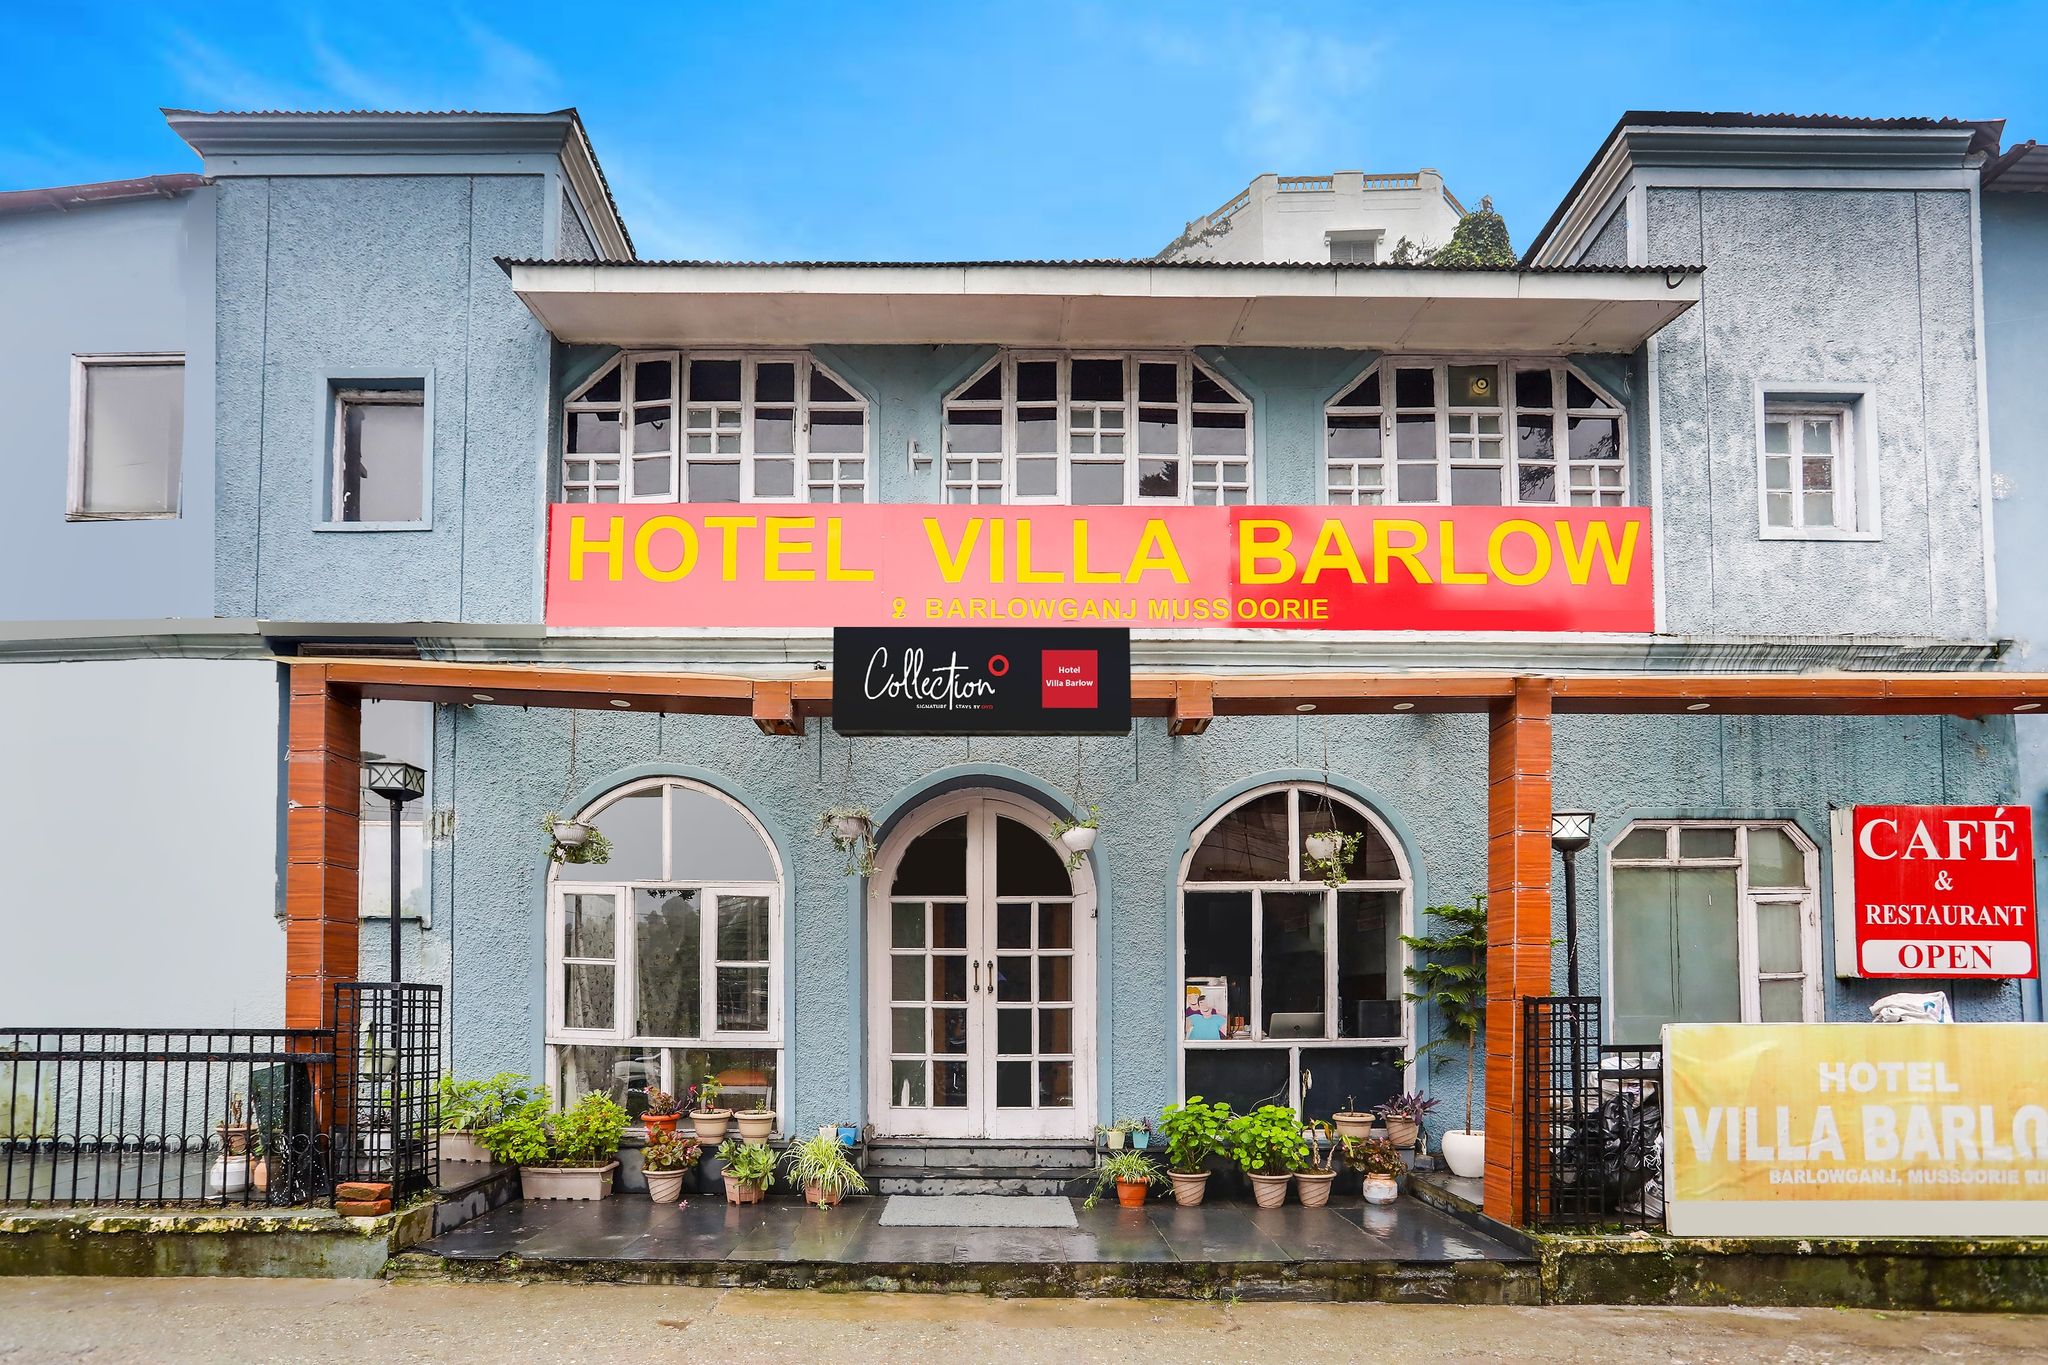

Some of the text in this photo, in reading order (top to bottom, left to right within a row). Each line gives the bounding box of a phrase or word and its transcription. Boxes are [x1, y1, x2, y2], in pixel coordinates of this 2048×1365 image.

[569, 516, 1639, 586] HOTEL VILLA BARLOW
[926, 598, 1137, 620] BARLOWGANJ
[865, 647, 995, 710] Collection
[1859, 807, 2018, 862] CAFÉ
[1934, 870, 1954, 892] &
[1865, 905, 2026, 926] RESTAURANT
[1898, 944, 1993, 969] OPEN
[1818, 1061, 1958, 1093] HOTEL
[1683, 1105, 1845, 1162] VILLA
[1907, 1169, 2019, 1185] MUSSOORIE
